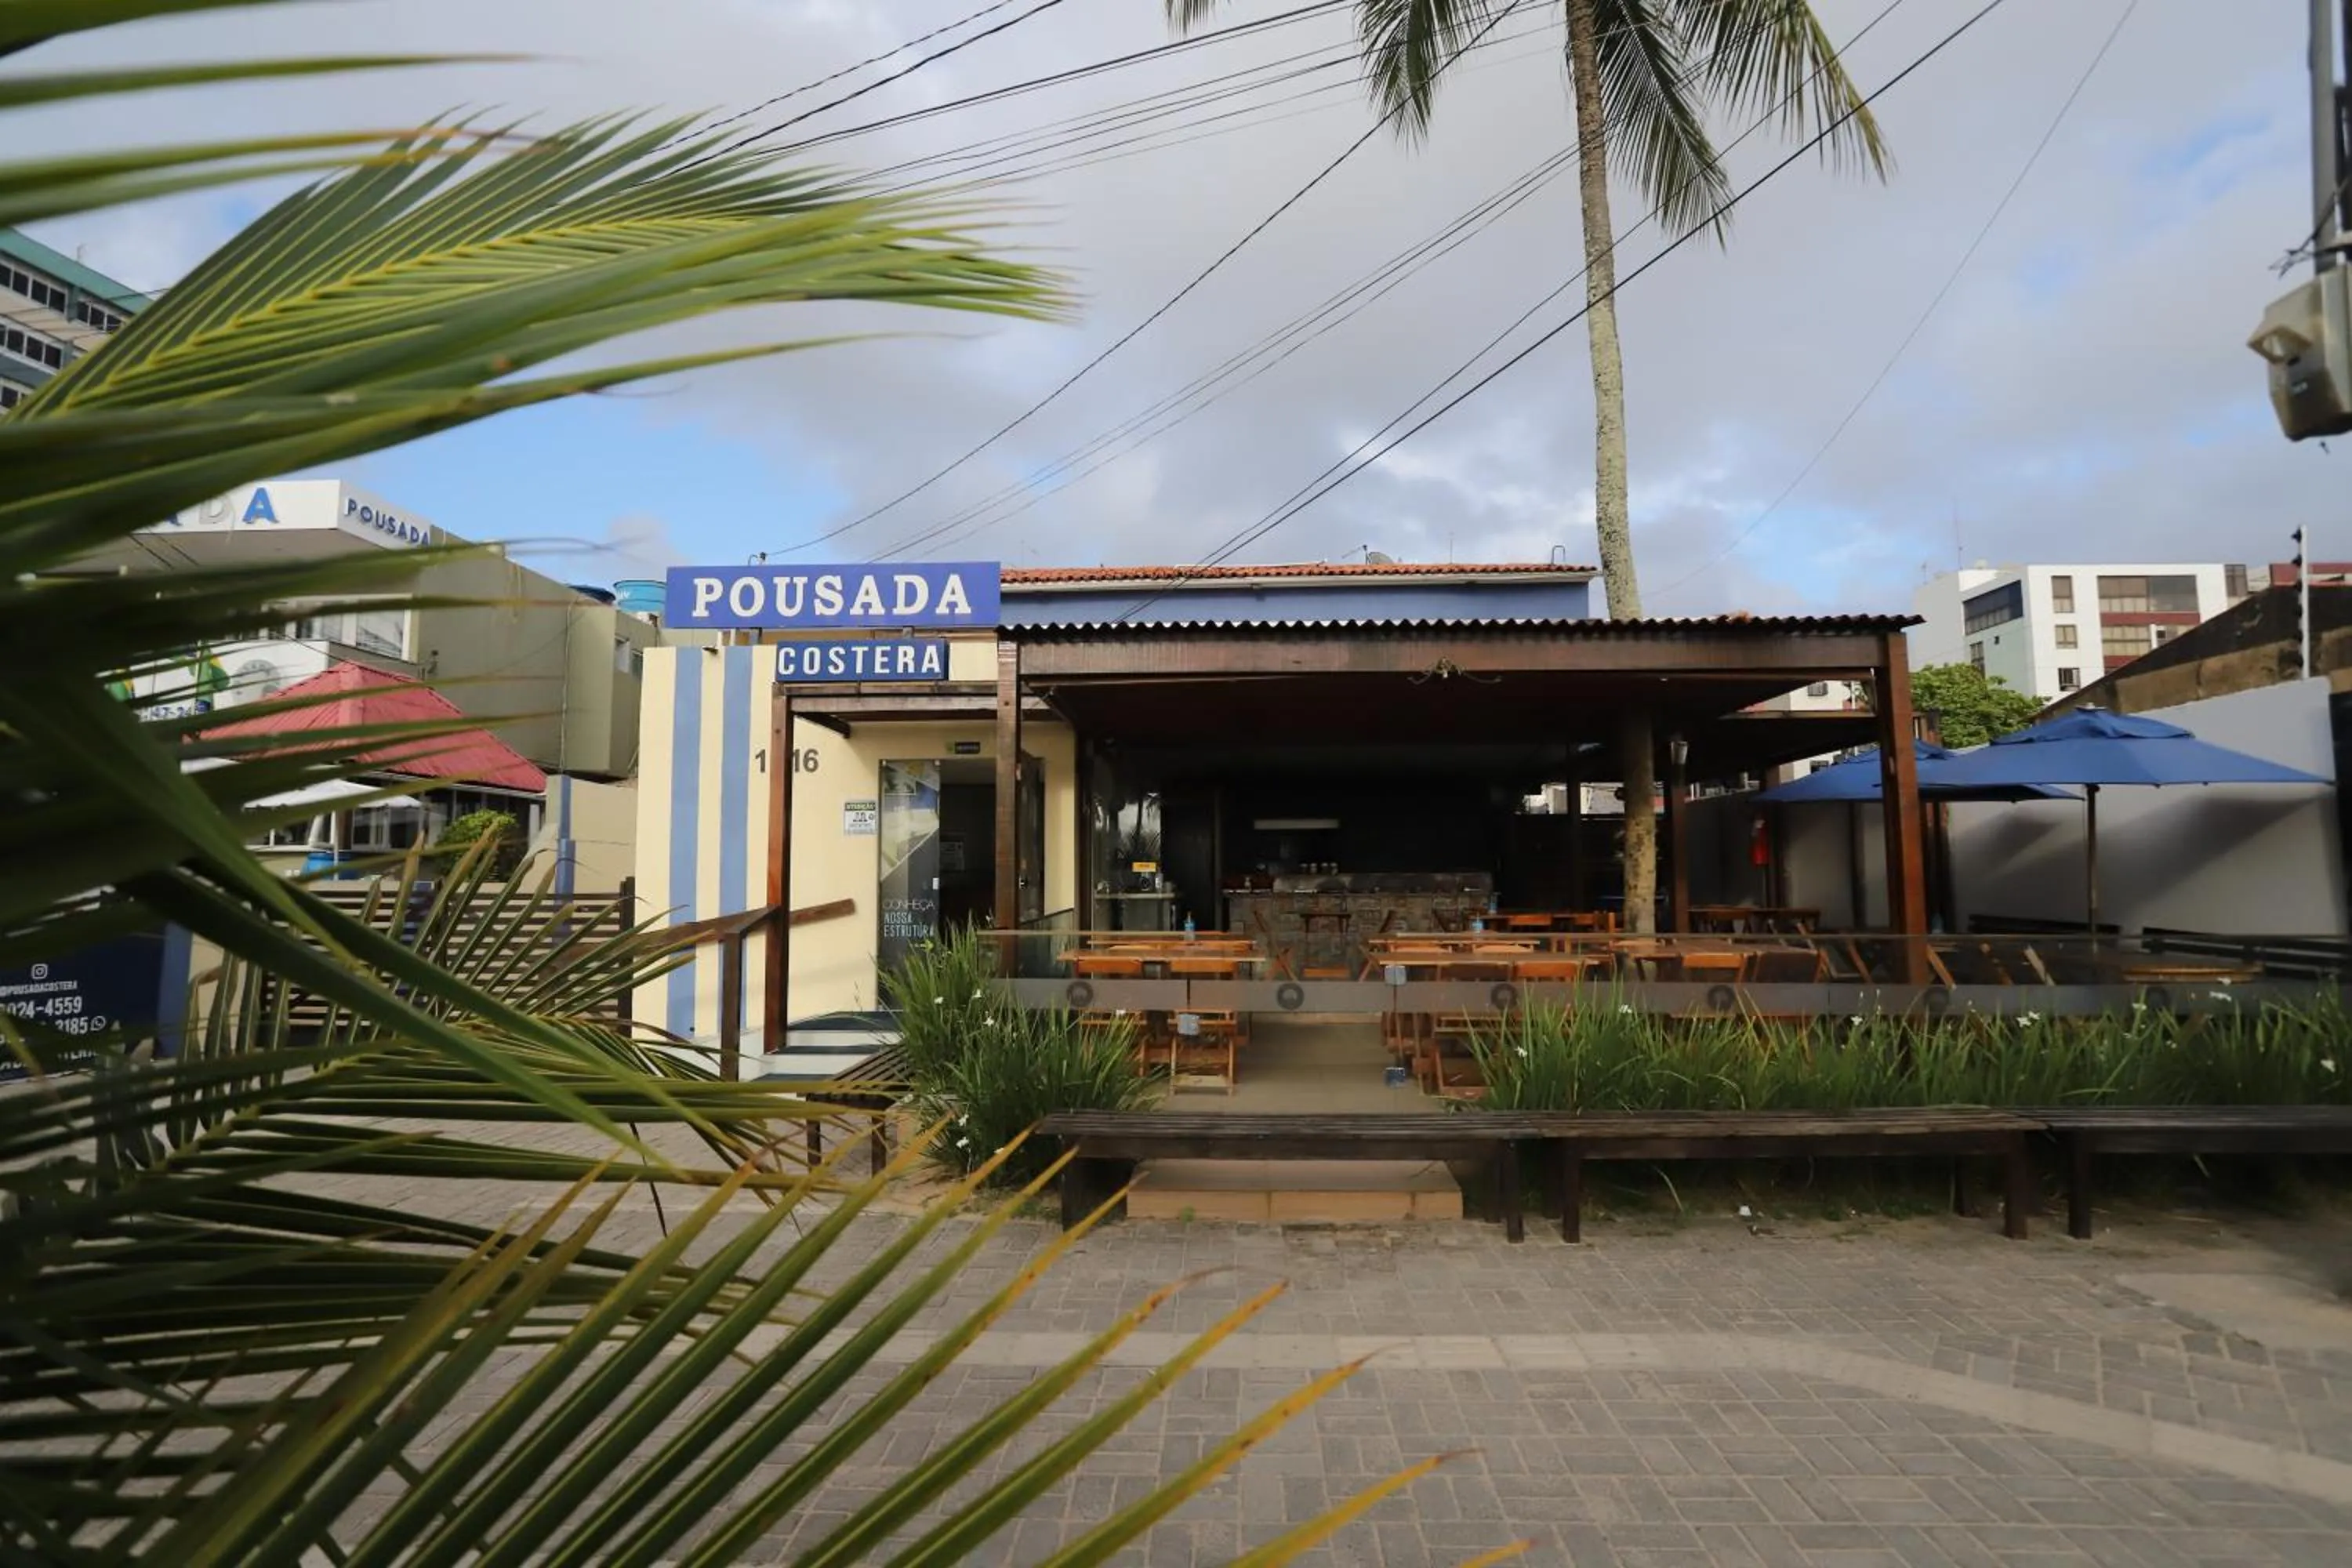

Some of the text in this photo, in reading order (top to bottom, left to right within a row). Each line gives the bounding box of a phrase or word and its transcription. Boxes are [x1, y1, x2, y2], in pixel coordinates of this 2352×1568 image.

[344, 497, 430, 546] POUSADA
[691, 574, 971, 617] POUSADA
[778, 646, 941, 675] COSTERA
[883, 898, 935, 911] CONHEÇA
[884, 910, 912, 924] NOSSA
